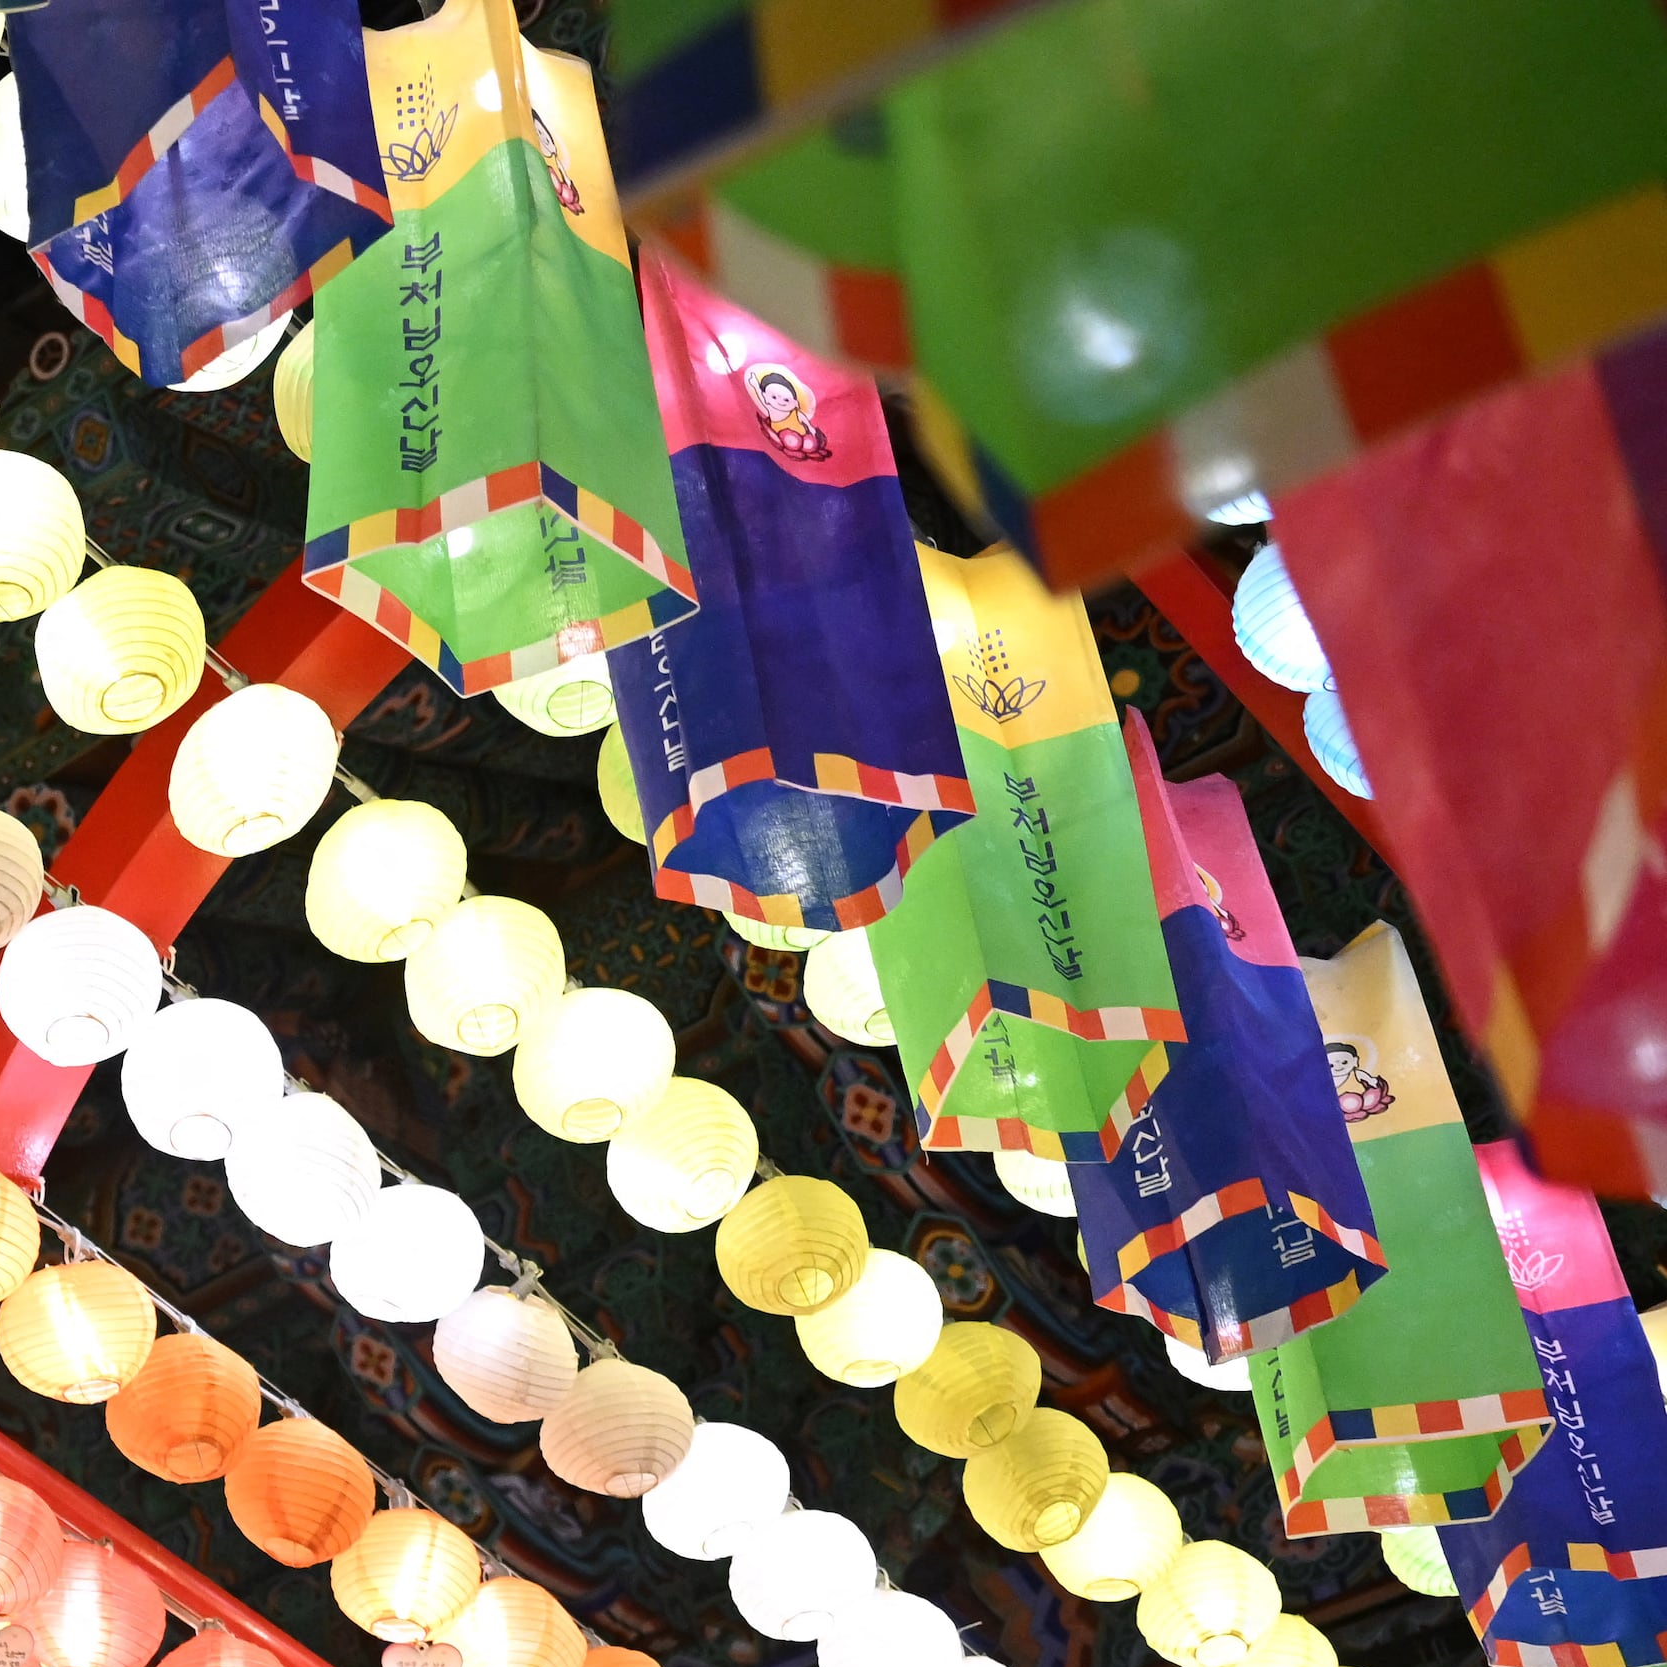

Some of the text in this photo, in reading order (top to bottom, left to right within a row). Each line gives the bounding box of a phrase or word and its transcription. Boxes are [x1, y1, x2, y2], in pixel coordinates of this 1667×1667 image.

[398, 232, 443, 474] 부처님오신날
[1003, 771, 1083, 981] 부처님오신날
[1533, 1336, 1616, 1526] 부처님오신날
